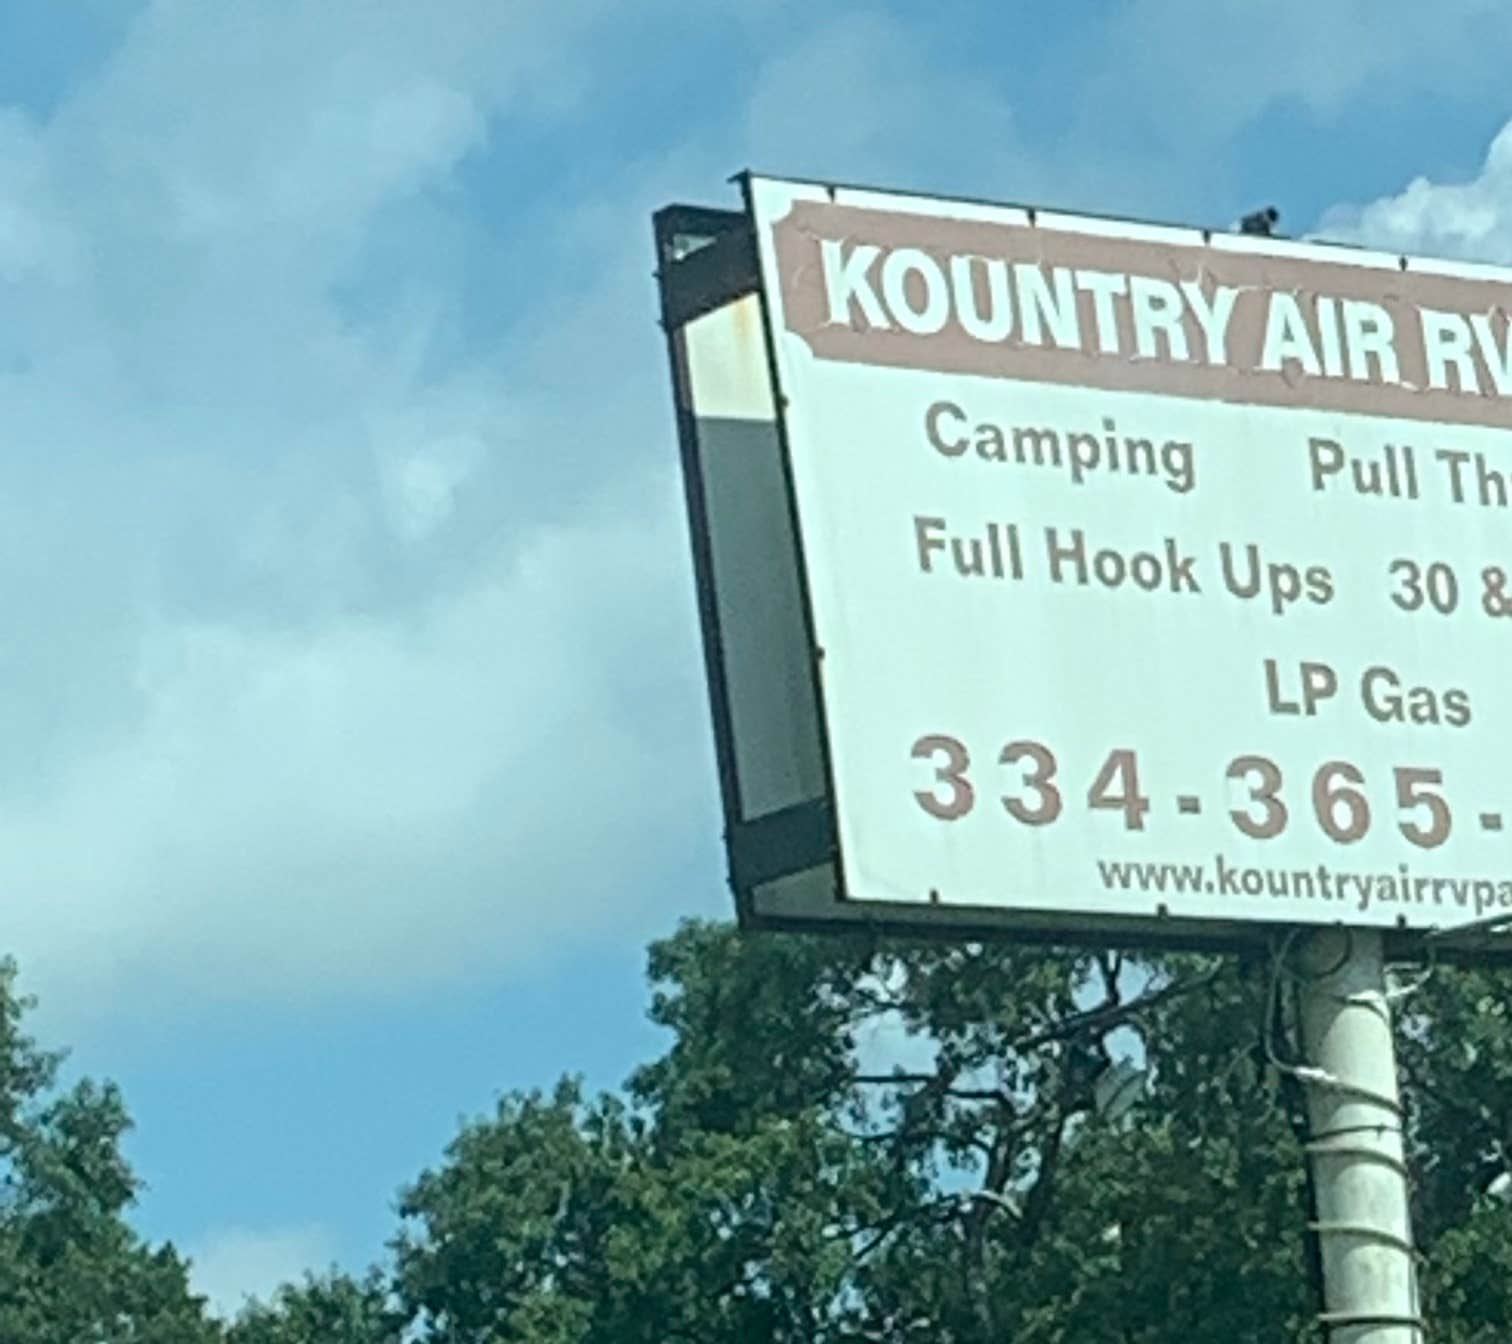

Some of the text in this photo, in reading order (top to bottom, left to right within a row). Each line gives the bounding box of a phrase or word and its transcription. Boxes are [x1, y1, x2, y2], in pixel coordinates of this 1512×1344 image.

[819, 238, 1238, 365] KOUNTRY
[1260, 290, 1401, 385] AIR
[925, 401, 1196, 494] Camping
[1308, 437, 1419, 501] Pull
[914, 515, 1335, 616] Full Hook Ups
[1389, 559, 1459, 616] 30
[1264, 659, 1473, 728] LP Gas
